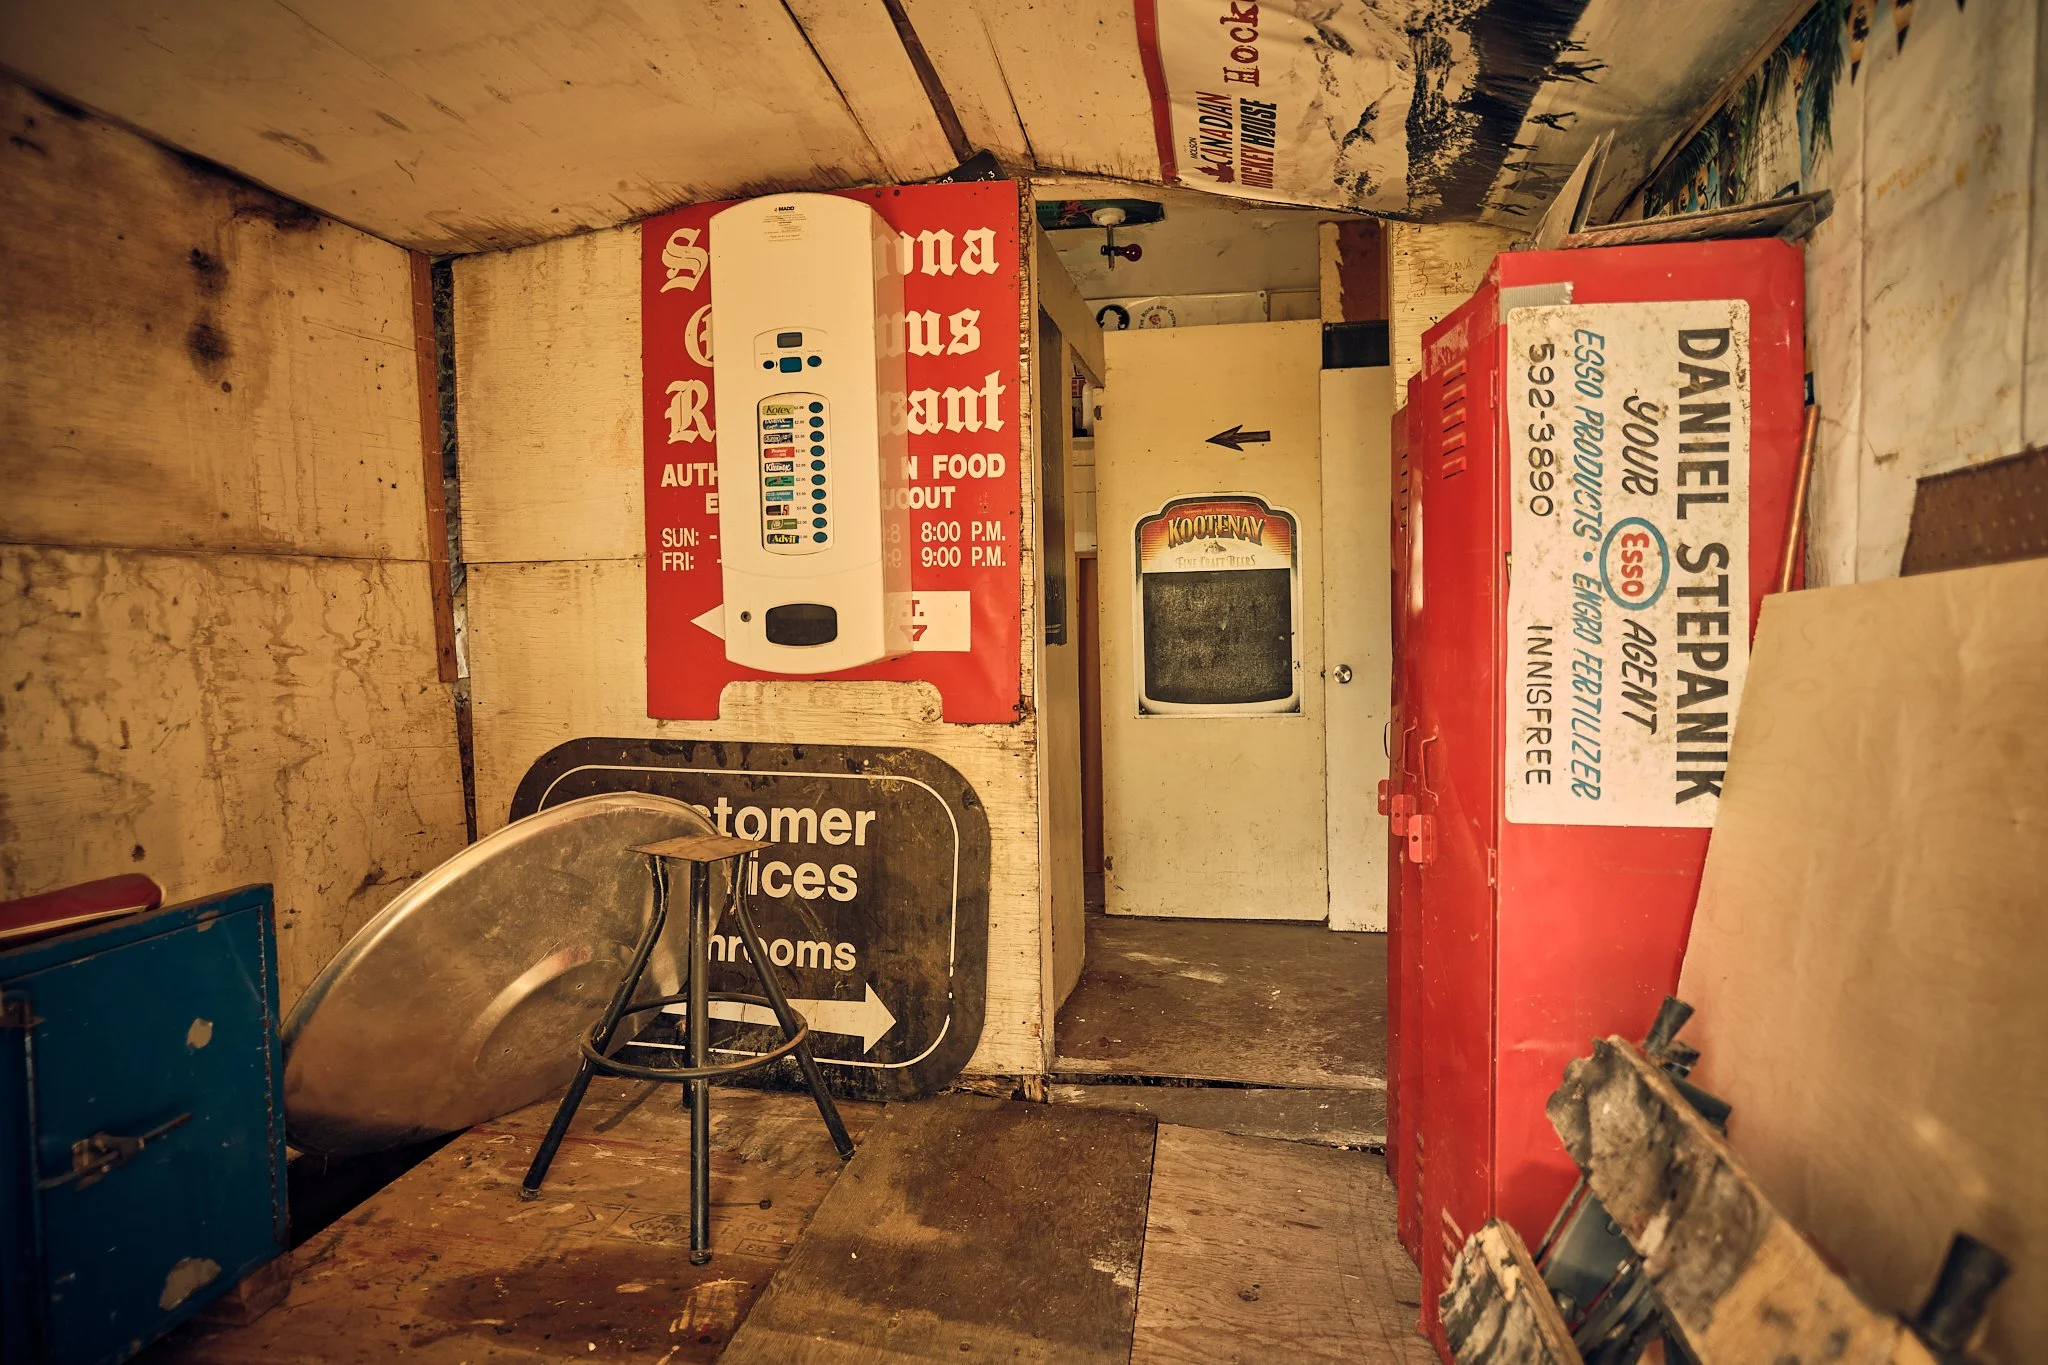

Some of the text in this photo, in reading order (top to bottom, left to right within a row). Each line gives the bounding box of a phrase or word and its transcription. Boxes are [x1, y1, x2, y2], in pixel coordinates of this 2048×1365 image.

[1195, 91, 1234, 166] CANADIAN
[1240, 97, 1277, 190] HOCKEY HOUSE
[932, 453, 1006, 480] FOOD
[1527, 342, 1556, 518] 592-3890
[661, 527, 700, 548] SUN:
[920, 521, 961, 543] 8:00
[971, 520, 1006, 541] P.M.
[662, 551, 695, 572] FRI:
[921, 546, 961, 568] 9:00
[971, 545, 1006, 567] P.M.
[772, 534, 797, 544] Advil
[1167, 513, 1266, 550] KOOTENAY
[1570, 328, 1606, 802] ESSO PRODUCTS ENGRO FERTILIZER
[1675, 327, 1731, 806] DANIEL STEPANIK
[1525, 625, 1554, 785] INNISFREE
[1621, 617, 1658, 736] AGENT
